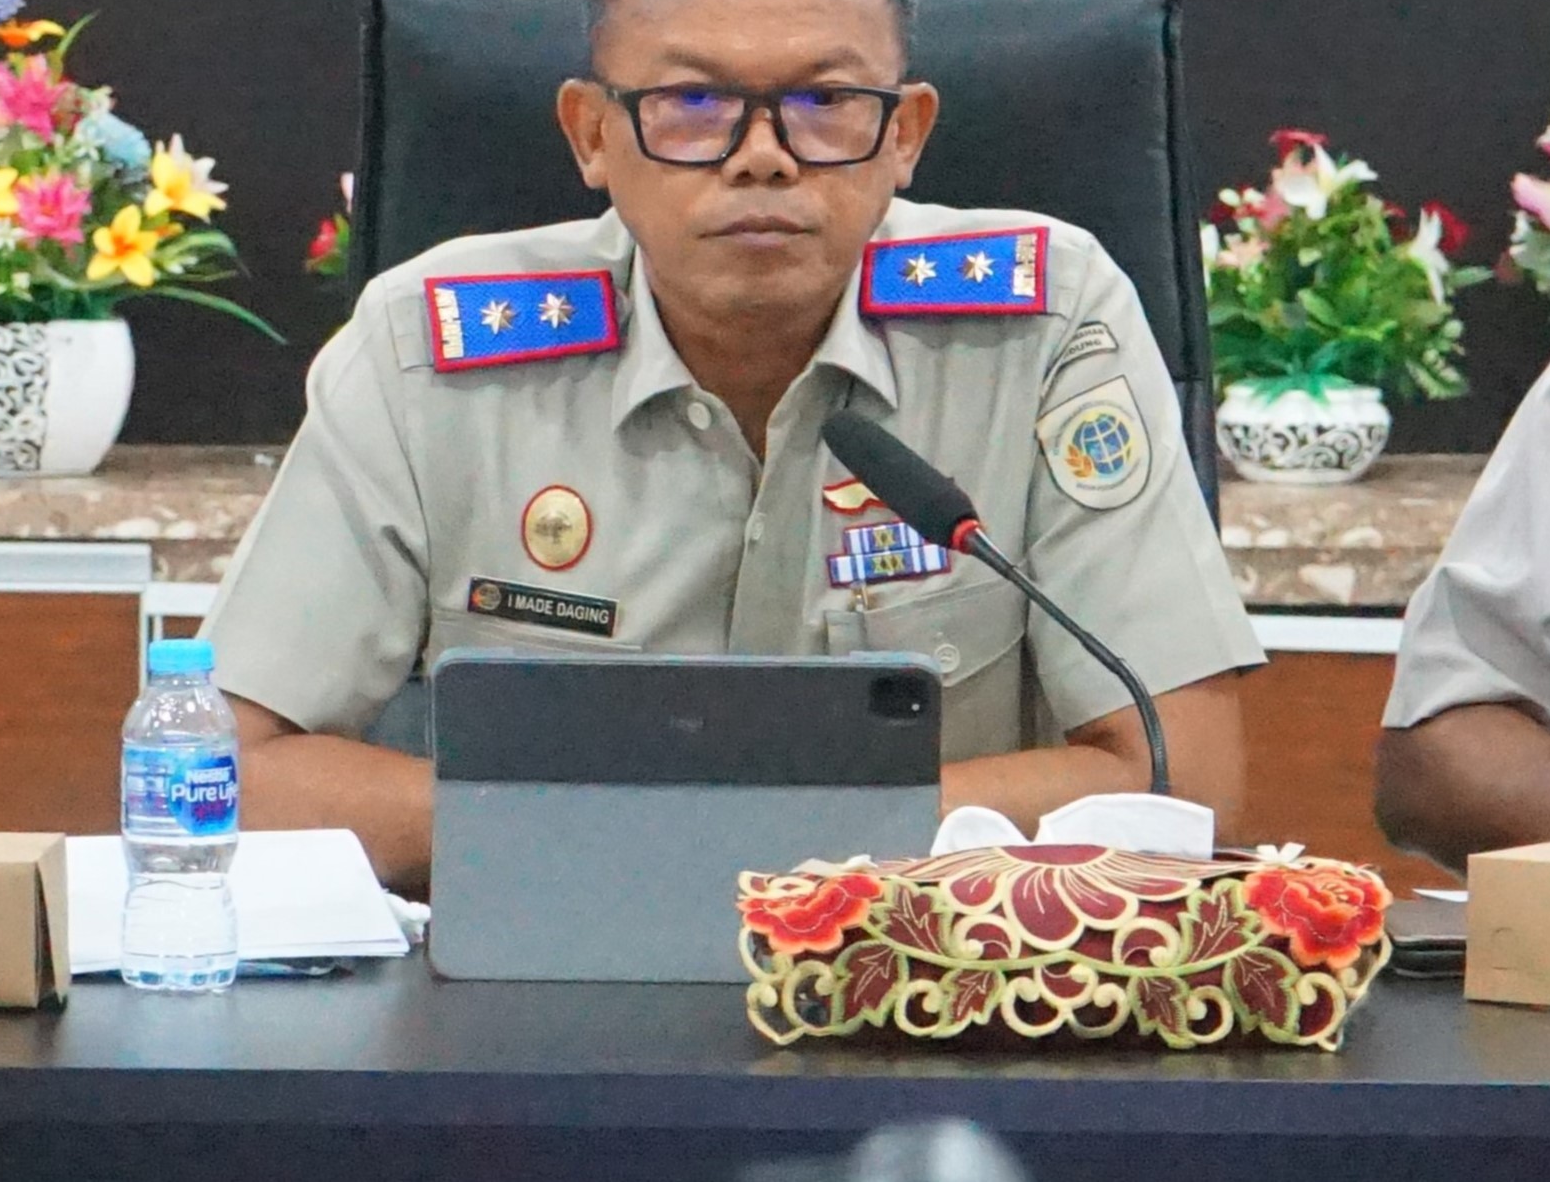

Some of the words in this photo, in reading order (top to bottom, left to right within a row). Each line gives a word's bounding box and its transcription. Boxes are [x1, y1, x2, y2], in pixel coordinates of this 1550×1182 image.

[514, 594, 554, 617] MADE
[556, 601, 610, 625] DAGING
[171, 783, 218, 803] Pure
